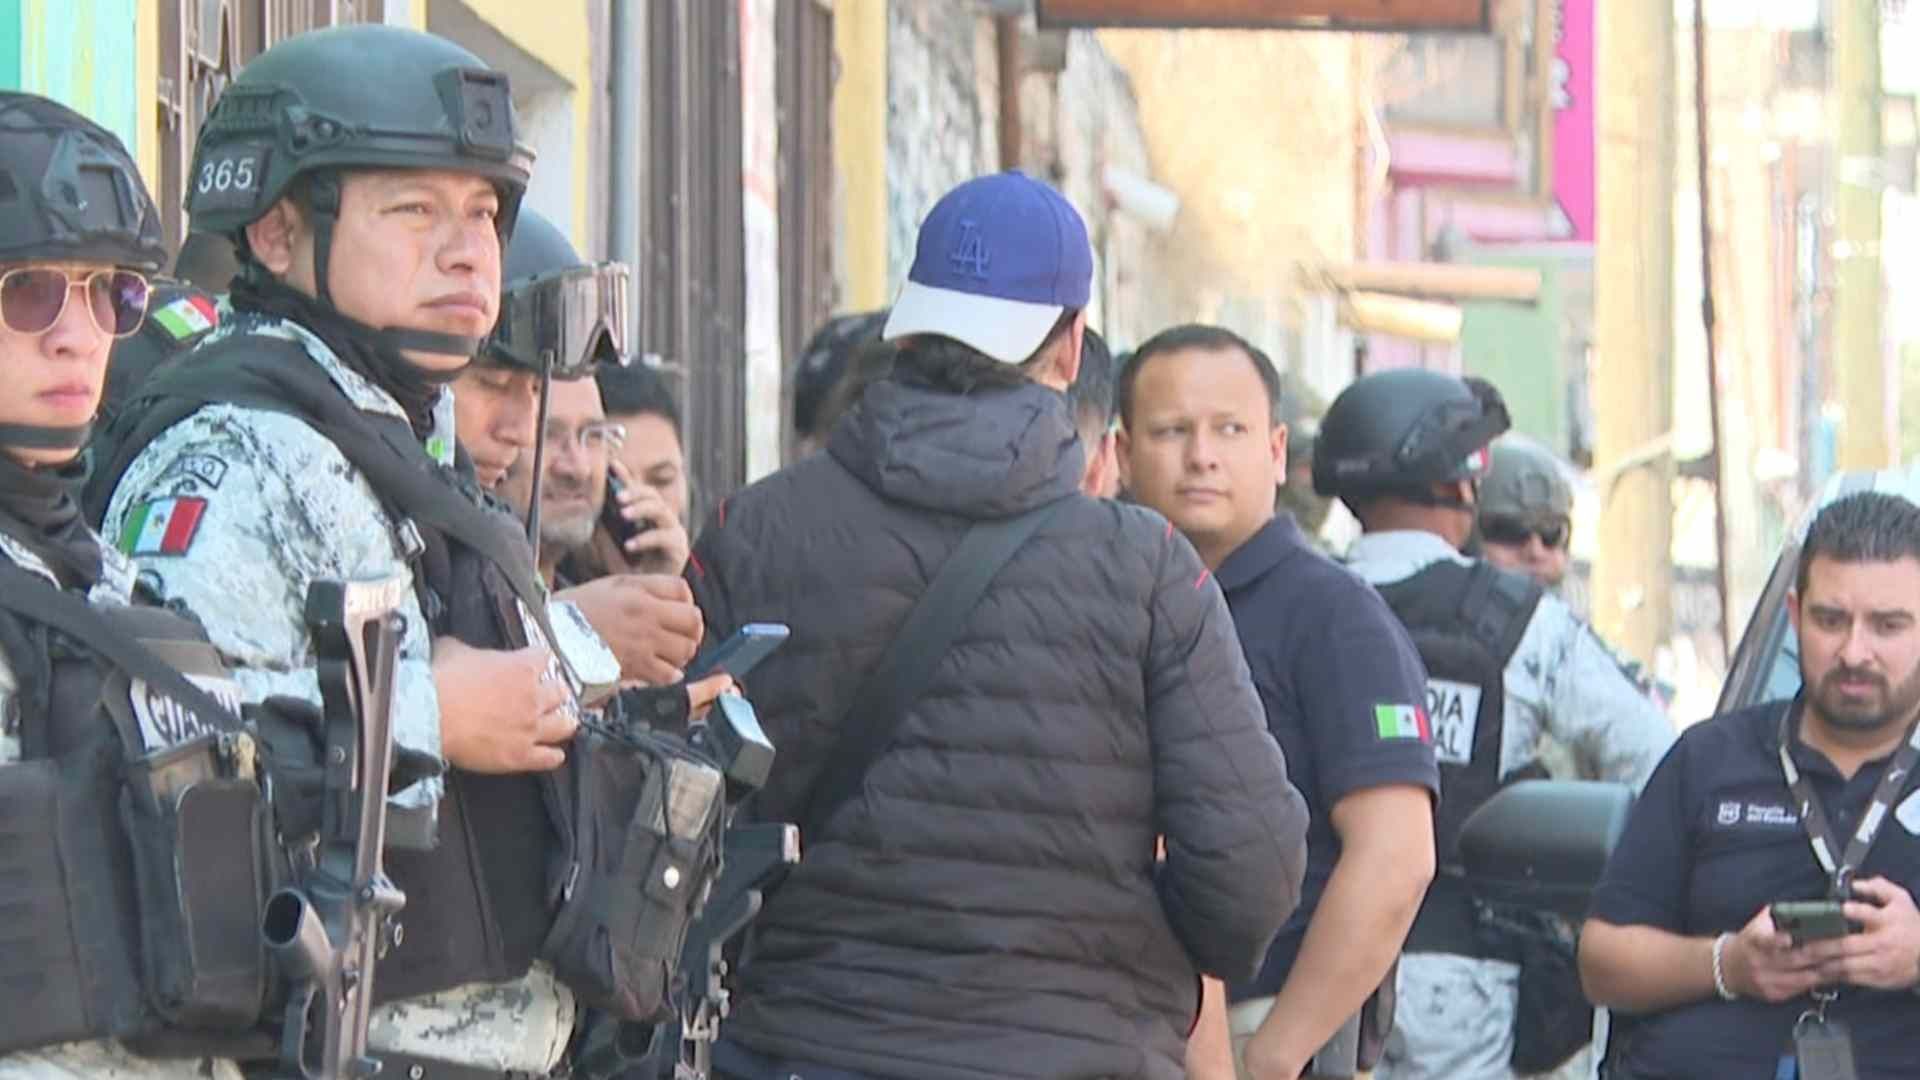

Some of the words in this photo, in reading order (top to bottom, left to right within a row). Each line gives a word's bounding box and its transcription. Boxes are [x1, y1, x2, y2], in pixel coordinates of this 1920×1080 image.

[198, 158, 255, 194] 365
[949, 218, 990, 279] LA
[1425, 688, 1464, 724] DIA
[1433, 725, 1462, 757] AL
